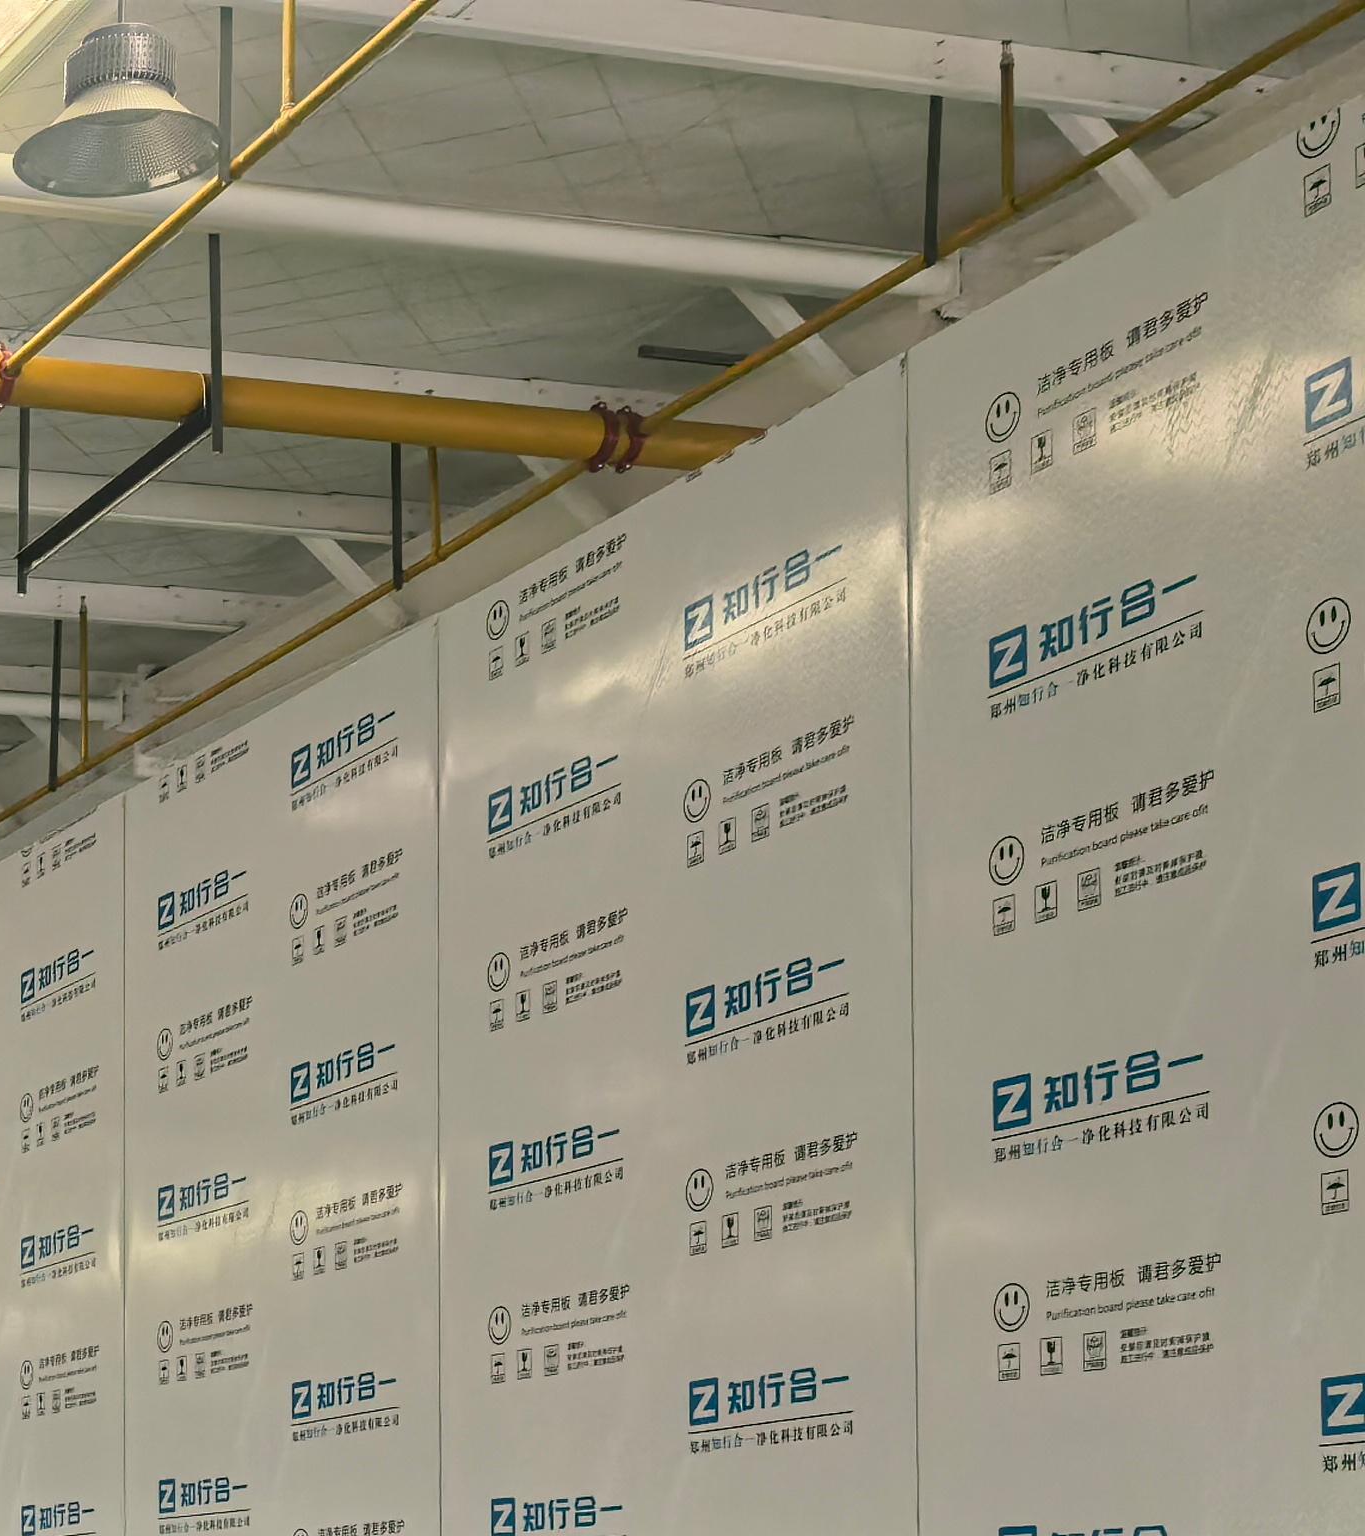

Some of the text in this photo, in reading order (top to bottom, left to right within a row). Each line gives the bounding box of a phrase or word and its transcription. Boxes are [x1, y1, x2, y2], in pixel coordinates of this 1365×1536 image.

[1036, 337, 1115, 396] 洁净专用板
[1126, 286, 1211, 350] 请君多爱护
[722, 543, 842, 625] 知行合一
[1038, 573, 1197, 663] 知行合一
[519, 753, 617, 816] 知行合一
[1040, 767, 1216, 846] 洁净专用板 请君多爱护
[724, 954, 844, 1018] 知行合一
[1044, 1046, 1203, 1114] 知行合一
[520, 1122, 619, 1173] 知行合一
[1045, 1252, 1223, 1299] 洁净专用板 请君多爱护
[727, 1366, 849, 1413] 知行合一
[523, 1494, 622, 1532] 知行合一
